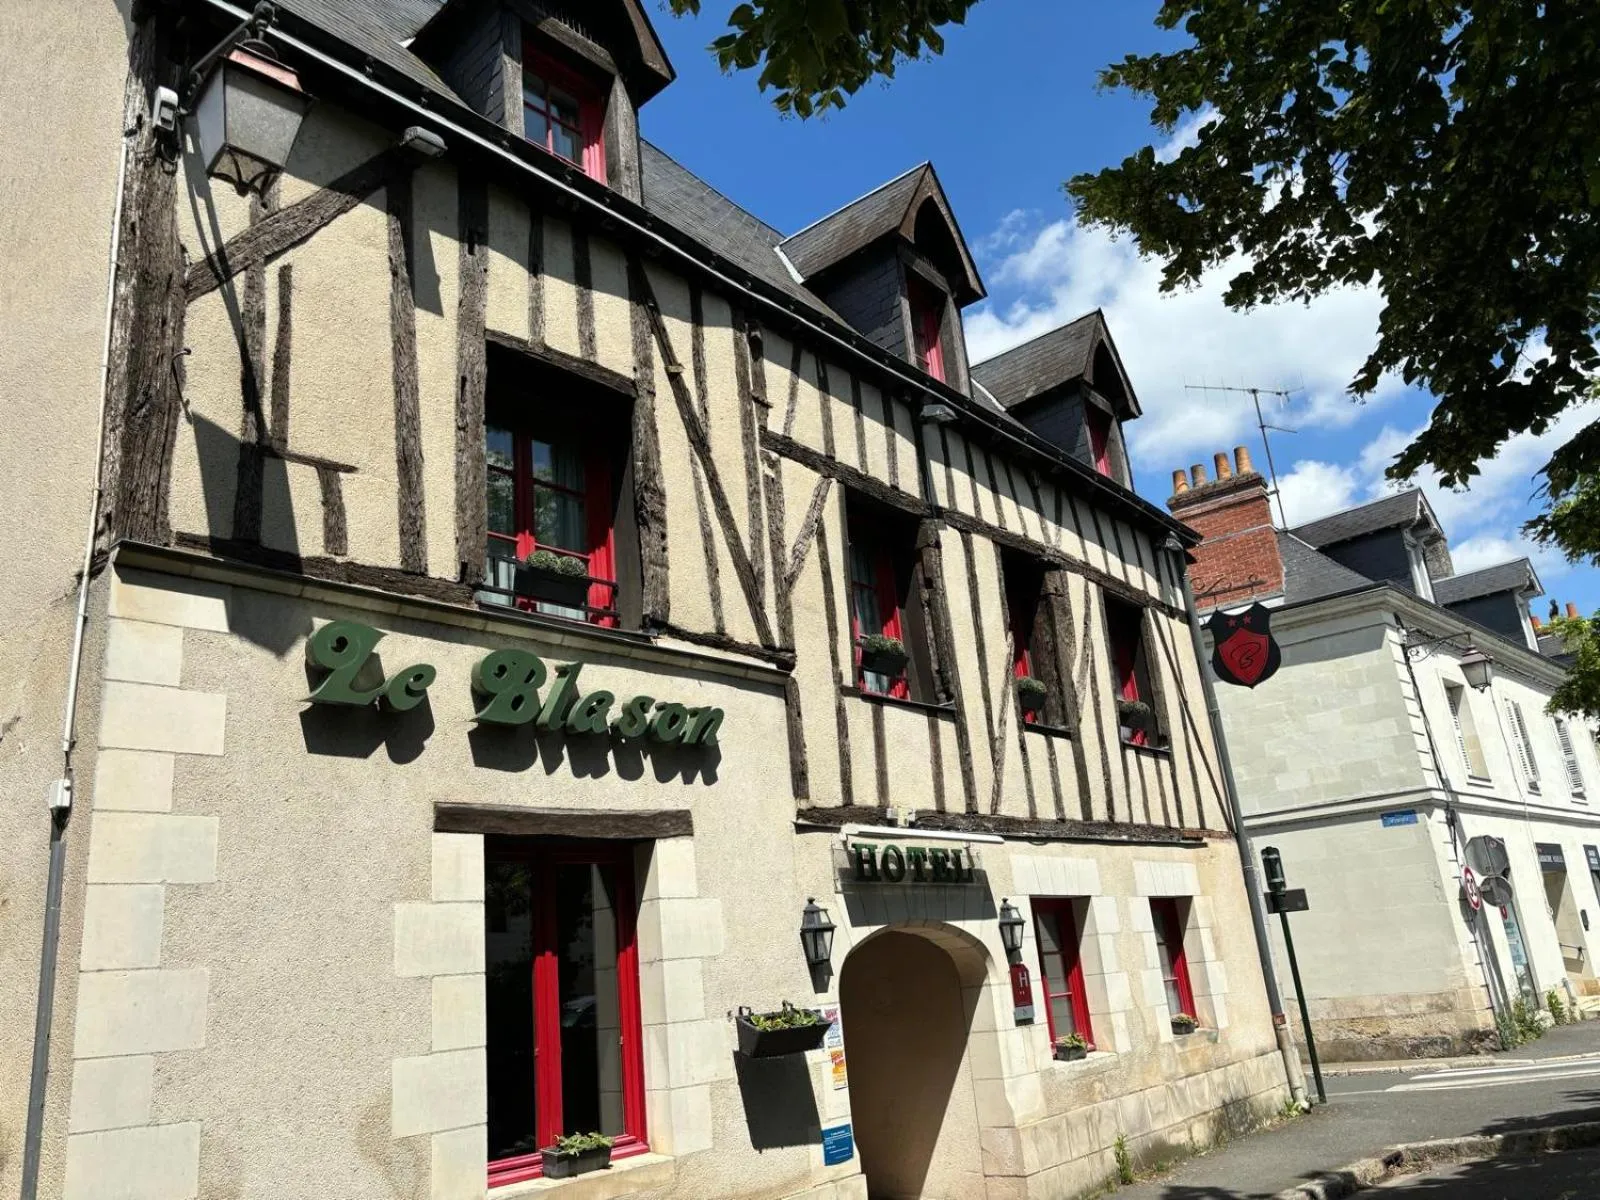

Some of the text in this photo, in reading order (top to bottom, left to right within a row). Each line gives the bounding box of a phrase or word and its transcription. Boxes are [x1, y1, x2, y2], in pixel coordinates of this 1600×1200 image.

[302, 619, 725, 746] Le Blason
[851, 843, 975, 883] HOTEL
[1018, 970, 1029, 988] H
